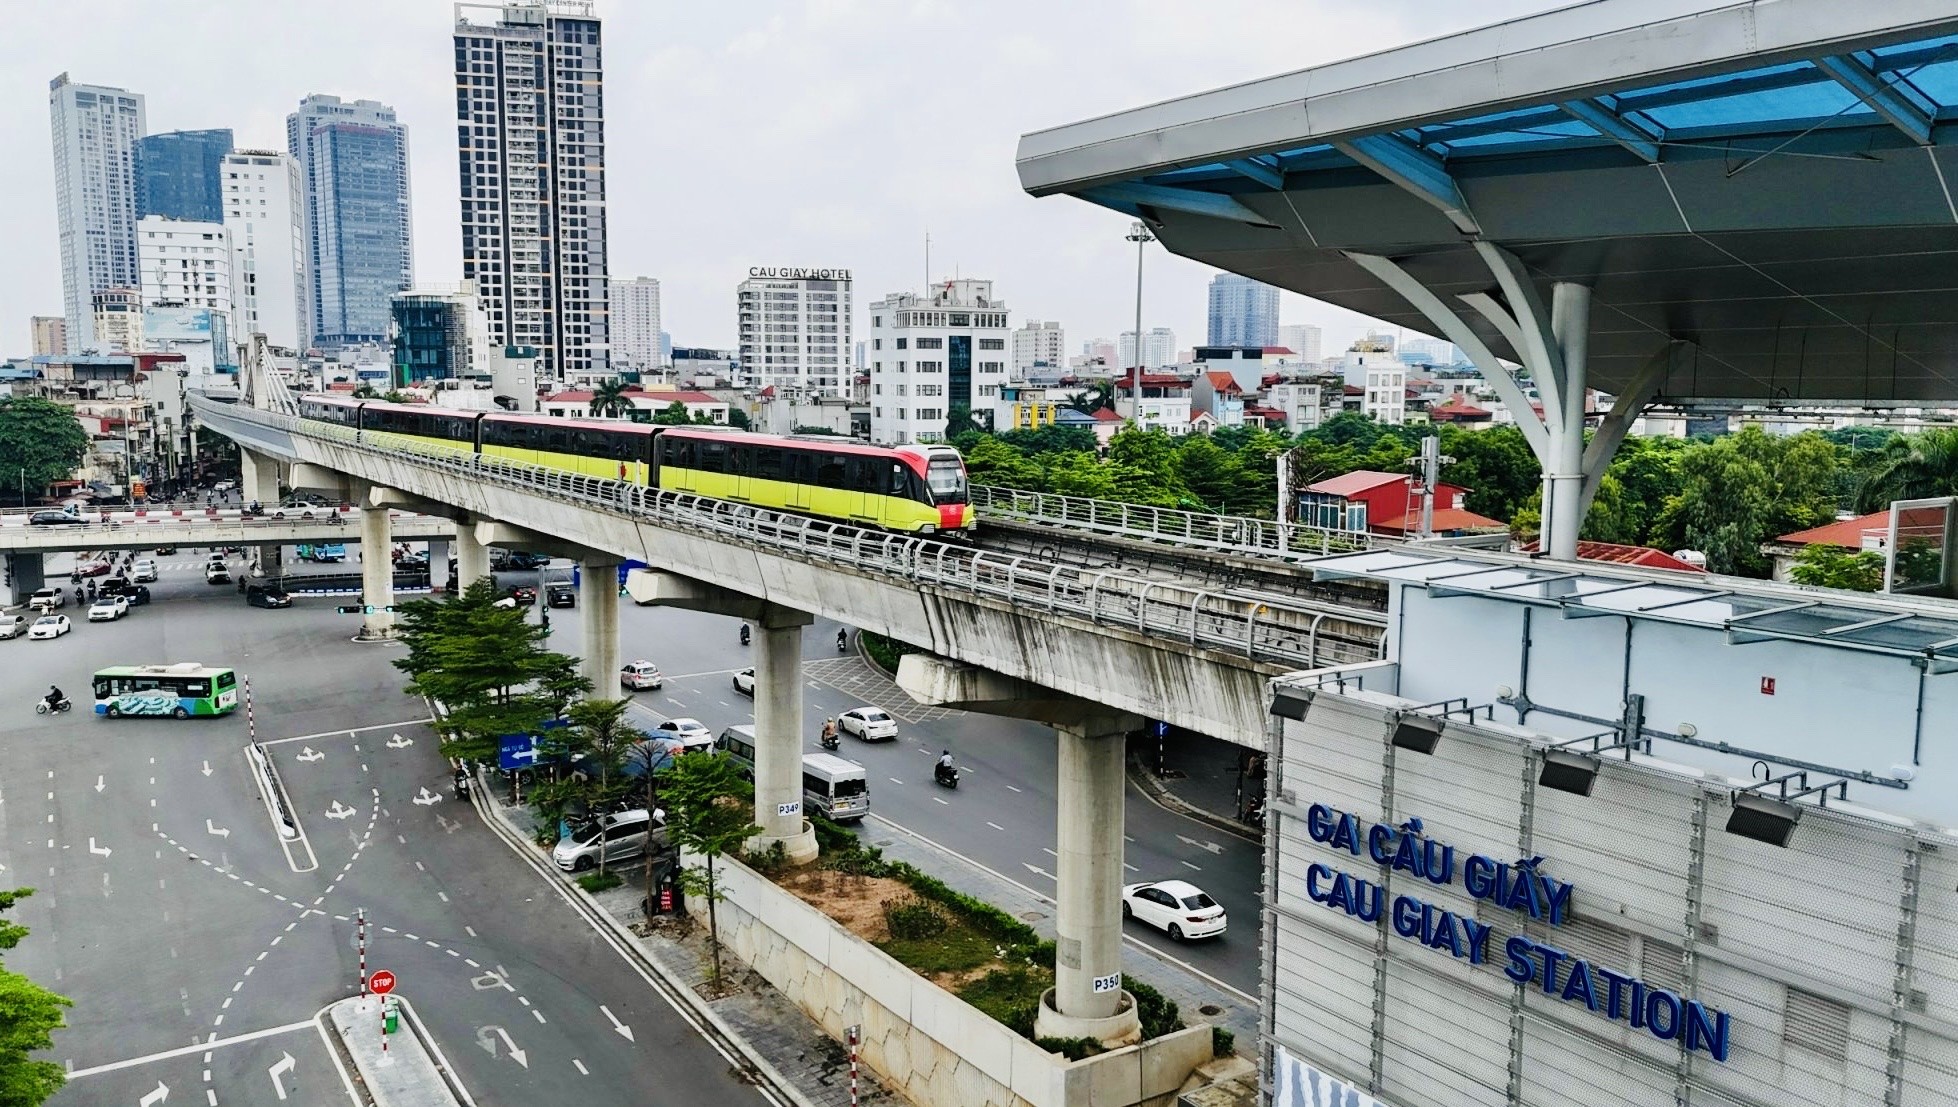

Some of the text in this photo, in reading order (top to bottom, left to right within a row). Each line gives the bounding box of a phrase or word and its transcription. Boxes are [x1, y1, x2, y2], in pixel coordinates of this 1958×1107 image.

[749, 266, 852, 279] CAU GIAY HOTEL
[779, 803, 799, 814] P349
[1308, 803, 1574, 927] GA CẦU GIẤY
[1306, 863, 1728, 1062] CAU GIAY STATION
[373, 977, 392, 988] STOP
[1095, 974, 1119, 991] P350
